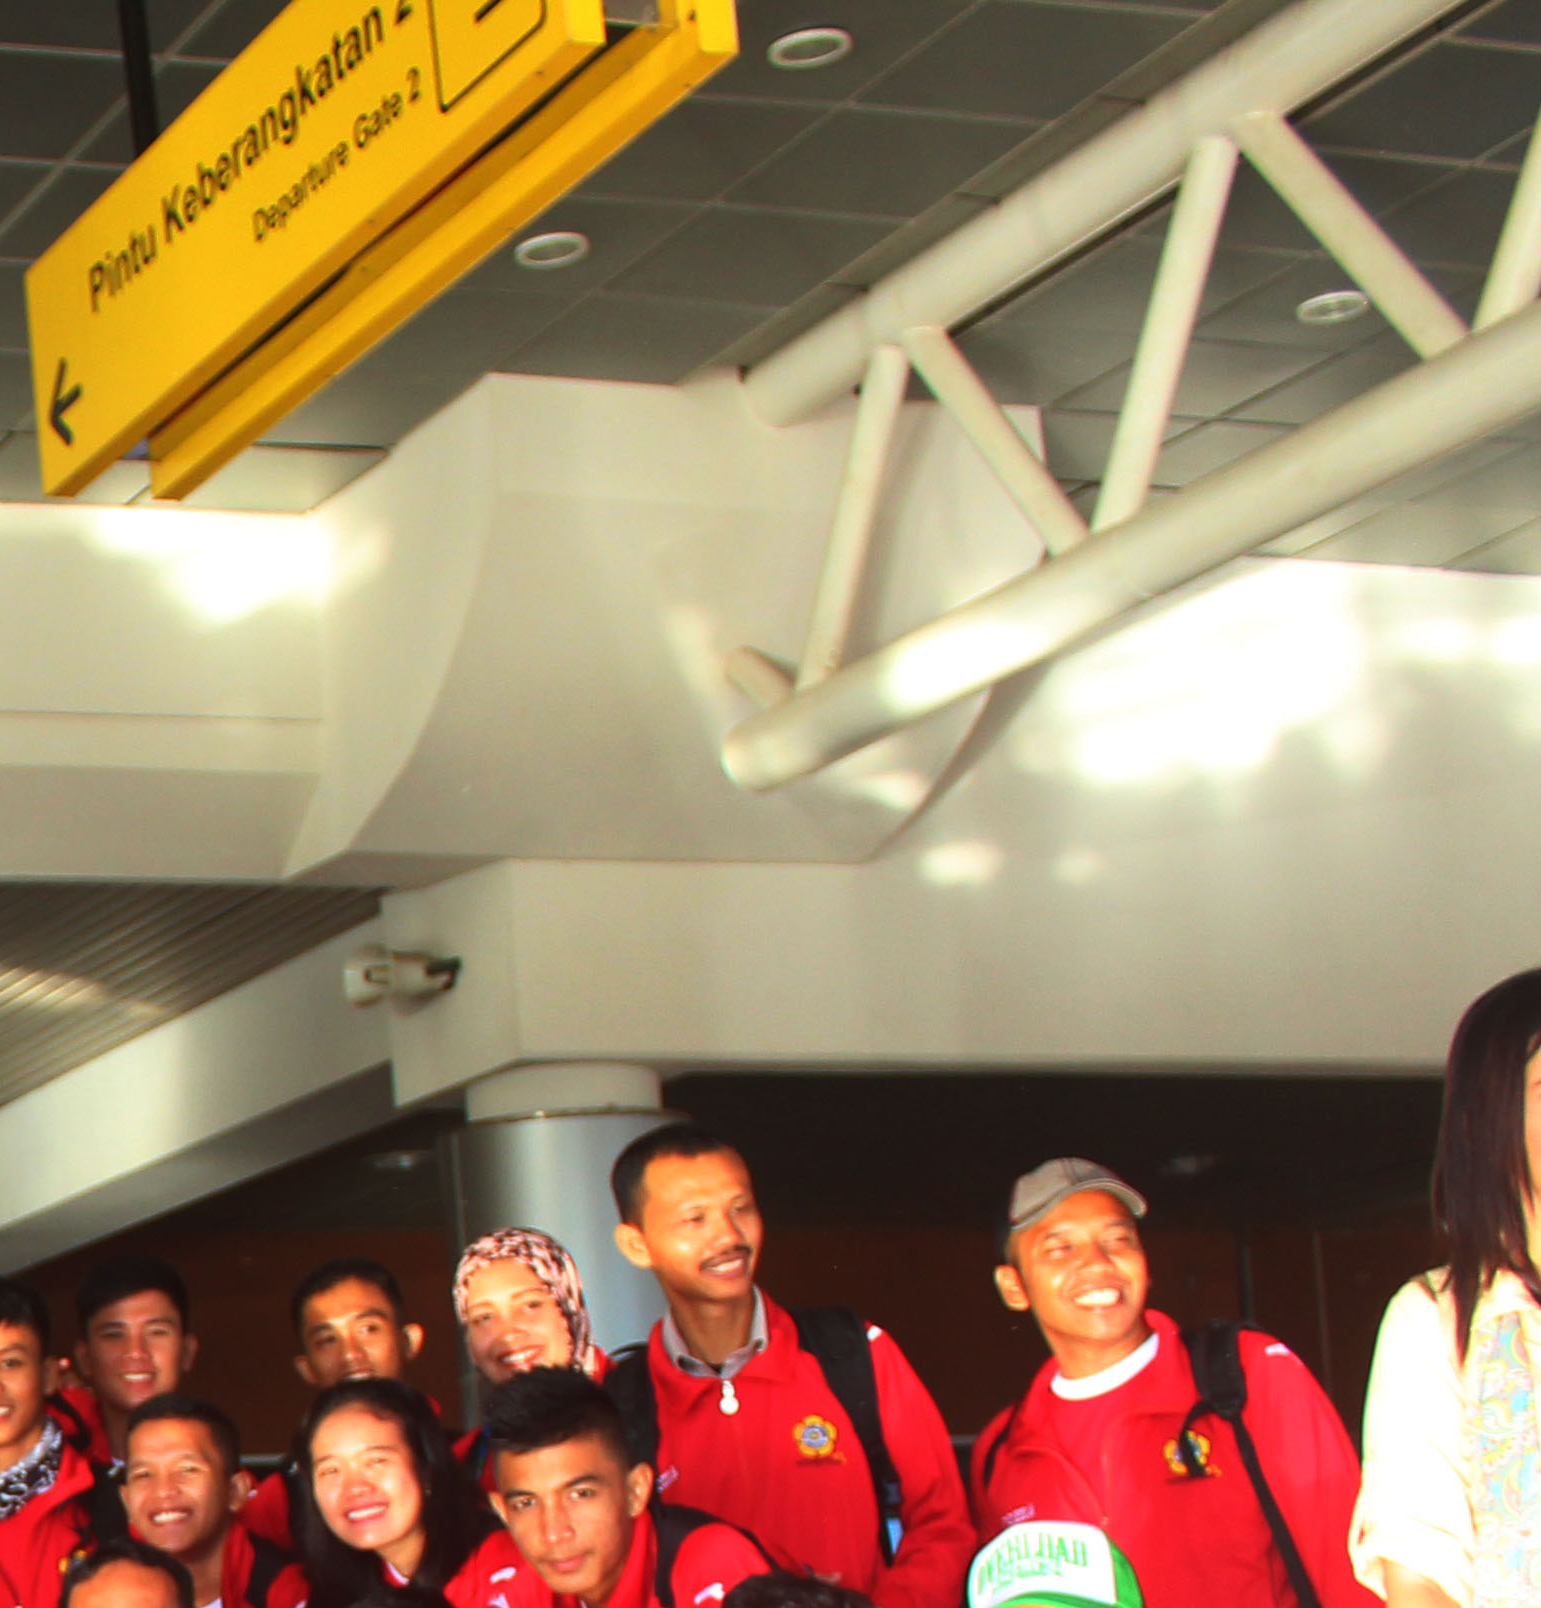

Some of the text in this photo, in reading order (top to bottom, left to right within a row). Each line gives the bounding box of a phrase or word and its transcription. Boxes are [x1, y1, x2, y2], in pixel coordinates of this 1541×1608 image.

[88, 5, 385, 313] Pintu Keberangkatan
[250, 66, 422, 243] Departure Gate 2
